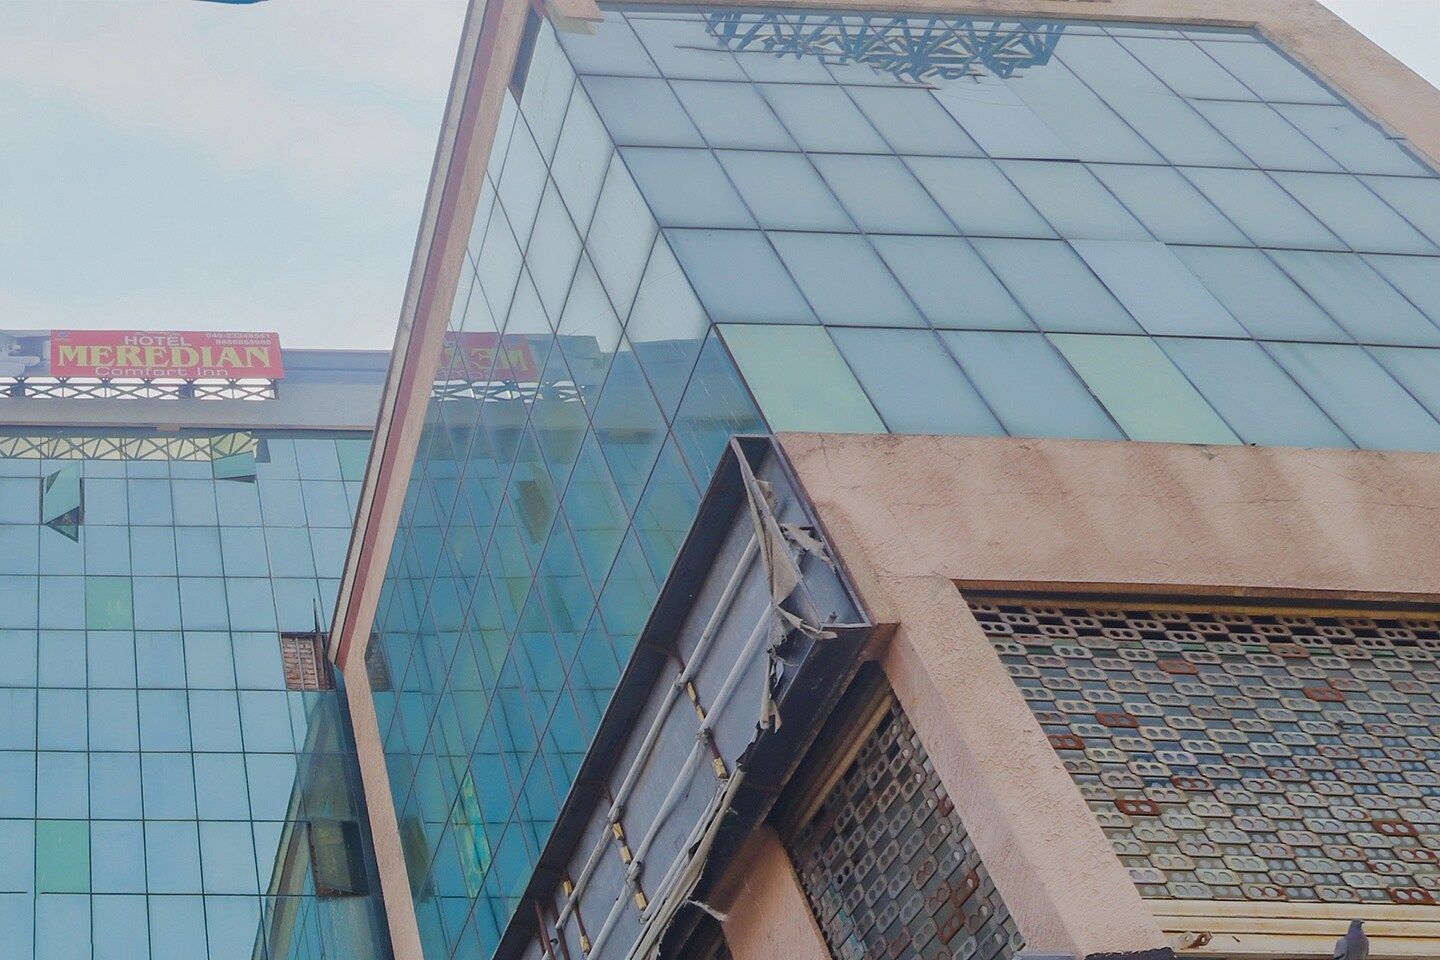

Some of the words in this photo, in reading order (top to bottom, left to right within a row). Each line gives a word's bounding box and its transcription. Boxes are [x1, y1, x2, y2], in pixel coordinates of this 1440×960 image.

[124, 336, 192, 346] HOTEL
[57, 345, 273, 368] MEREDIAN
[95, 366, 187, 377] Comfort
[197, 367, 228, 377] Inn
